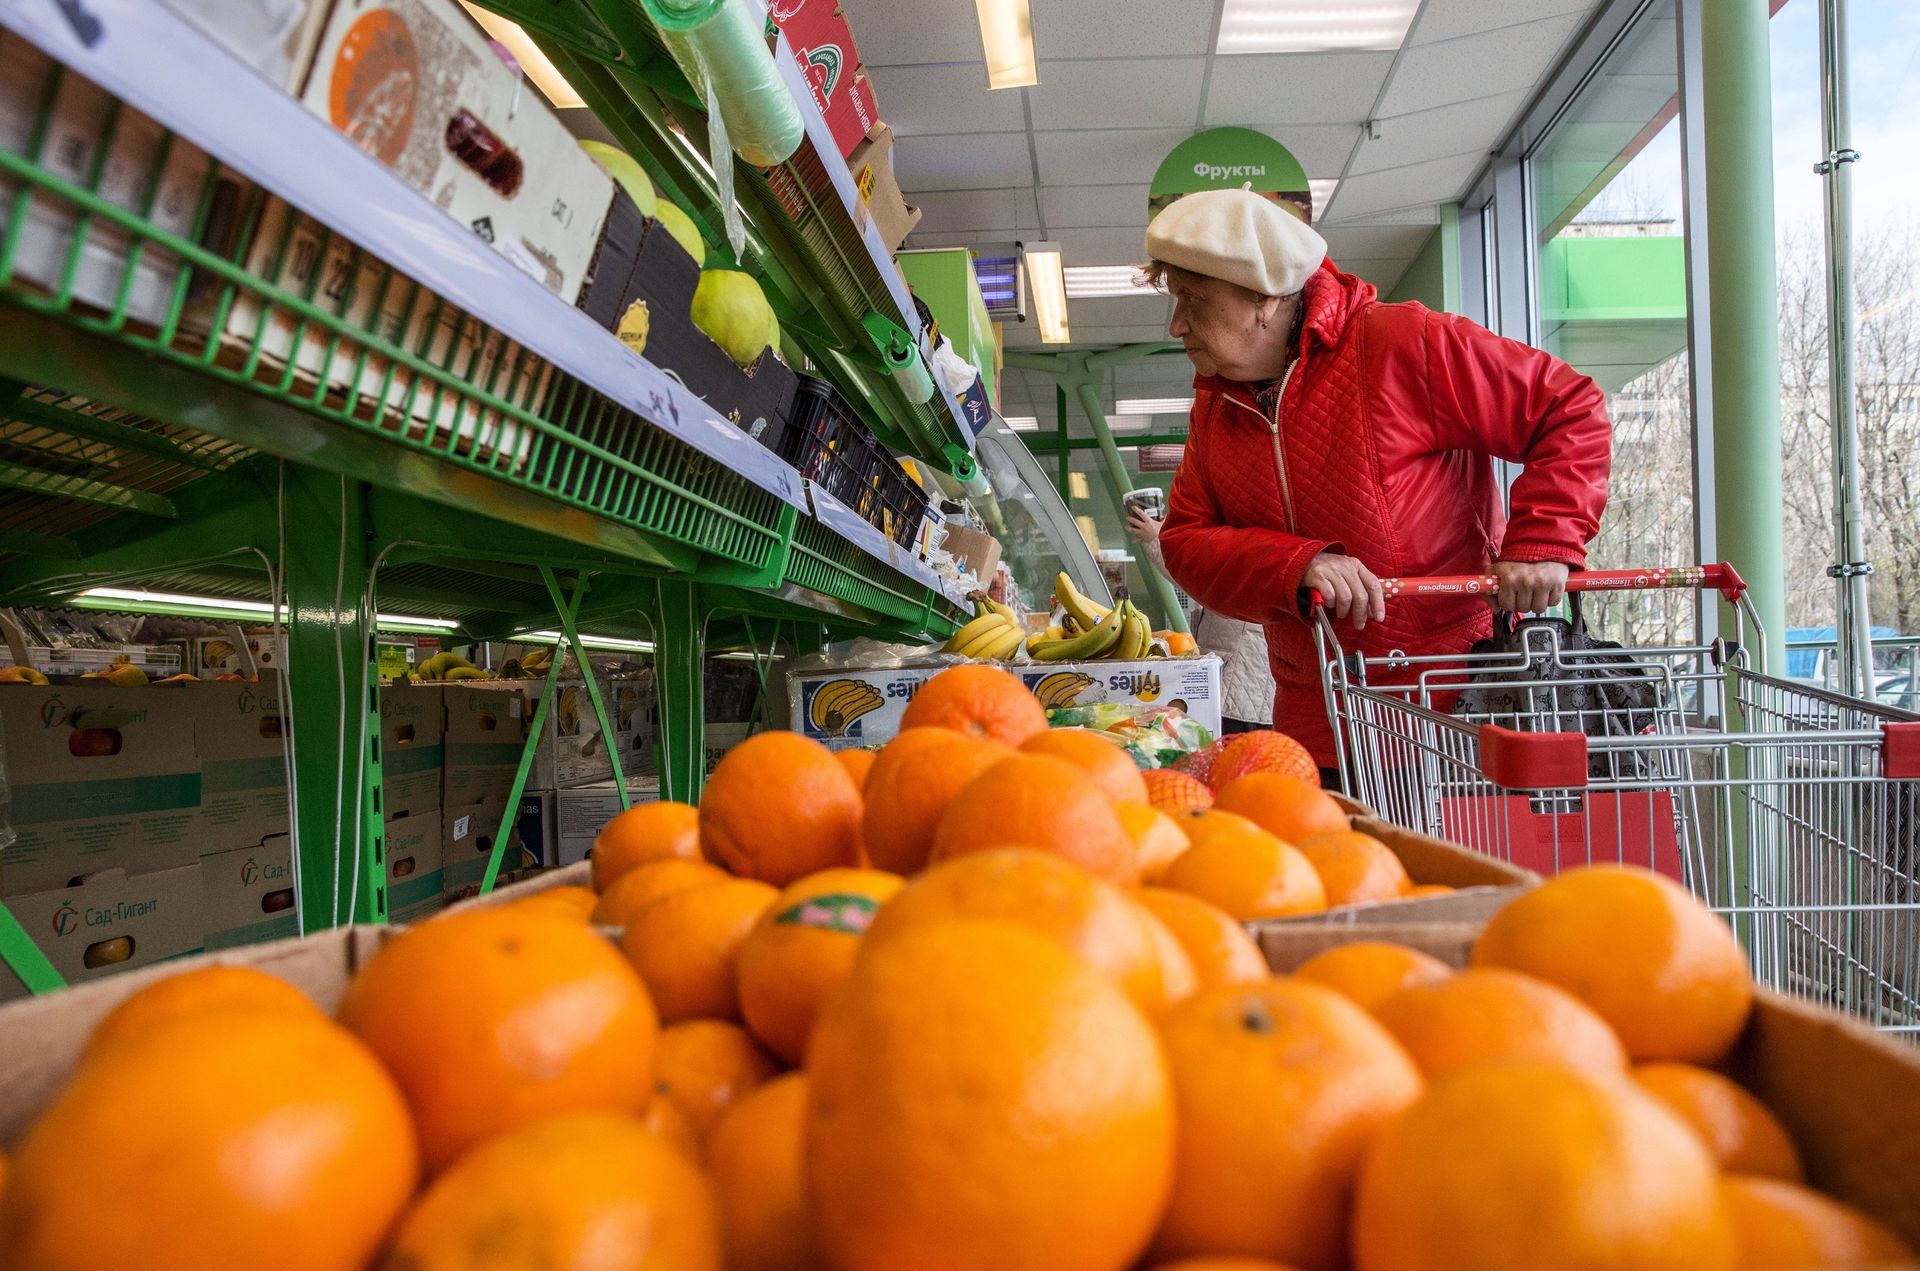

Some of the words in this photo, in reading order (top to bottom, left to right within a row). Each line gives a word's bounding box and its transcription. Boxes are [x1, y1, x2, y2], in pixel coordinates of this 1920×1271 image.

[848, 85, 867, 118] EVERYDAY
[860, 114, 872, 134] FRESH
[1193, 162, 1265, 180] Фрукты
[1109, 670, 1160, 695] fyffes
[263, 860, 291, 879] Сад-Г
[85, 899, 158, 927] Сад-Гигант
